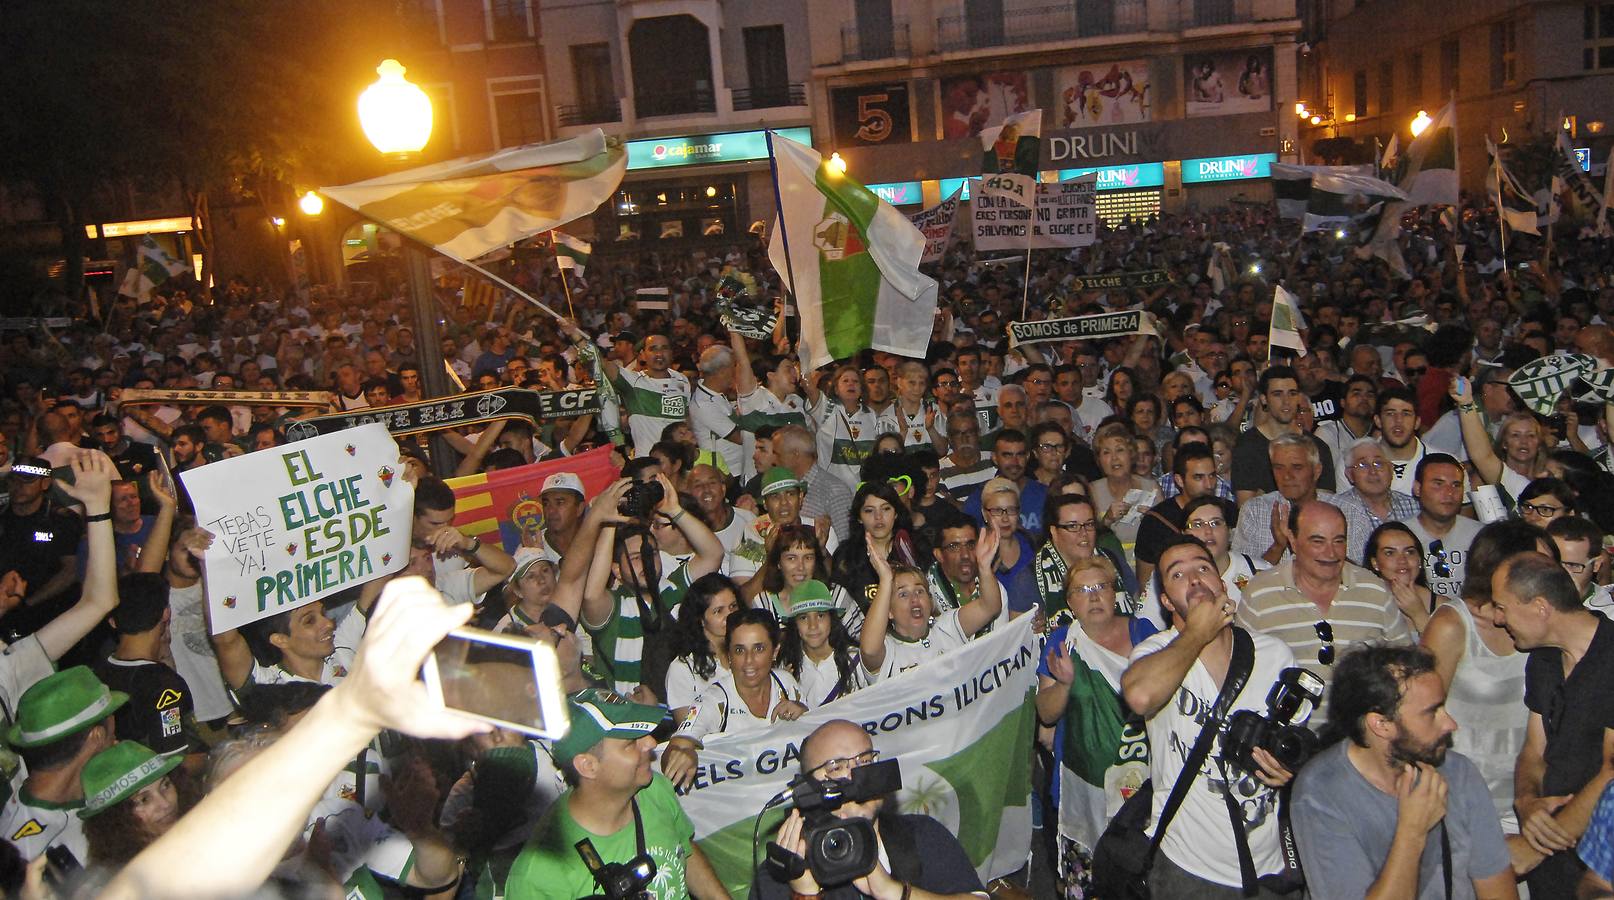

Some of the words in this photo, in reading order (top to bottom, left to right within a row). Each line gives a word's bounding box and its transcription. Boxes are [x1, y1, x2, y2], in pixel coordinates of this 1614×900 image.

[854, 94, 892, 141] 5
[668, 143, 722, 160] cajamar
[1050, 131, 1138, 161] DRUNI
[1199, 159, 1244, 175] DRUNI
[1037, 208, 1050, 221] NO
[1057, 207, 1088, 219] GRATA
[978, 225, 1026, 236] SALVEMOS
[1049, 224, 1075, 235] ELCHE
[1086, 278, 1121, 288] ELCHE
[1014, 322, 1060, 338] SOMOS
[1064, 321, 1078, 334] de
[1080, 314, 1138, 332] PRIMERA
[419, 401, 465, 424] ELX
[540, 394, 553, 411] E
[560, 390, 597, 409] CF
[282, 449, 324, 487] EL
[278, 473, 370, 531] ELCHE
[207, 506, 272, 536] TEBAS
[222, 528, 276, 555] VETE
[234, 551, 267, 577] YA!
[164, 724, 180, 736] LFP
[96, 773, 138, 806] SOMOS
[140, 760, 157, 776] DE
[676, 759, 743, 795] ELS
[1284, 826, 1297, 869] DIGITAL
